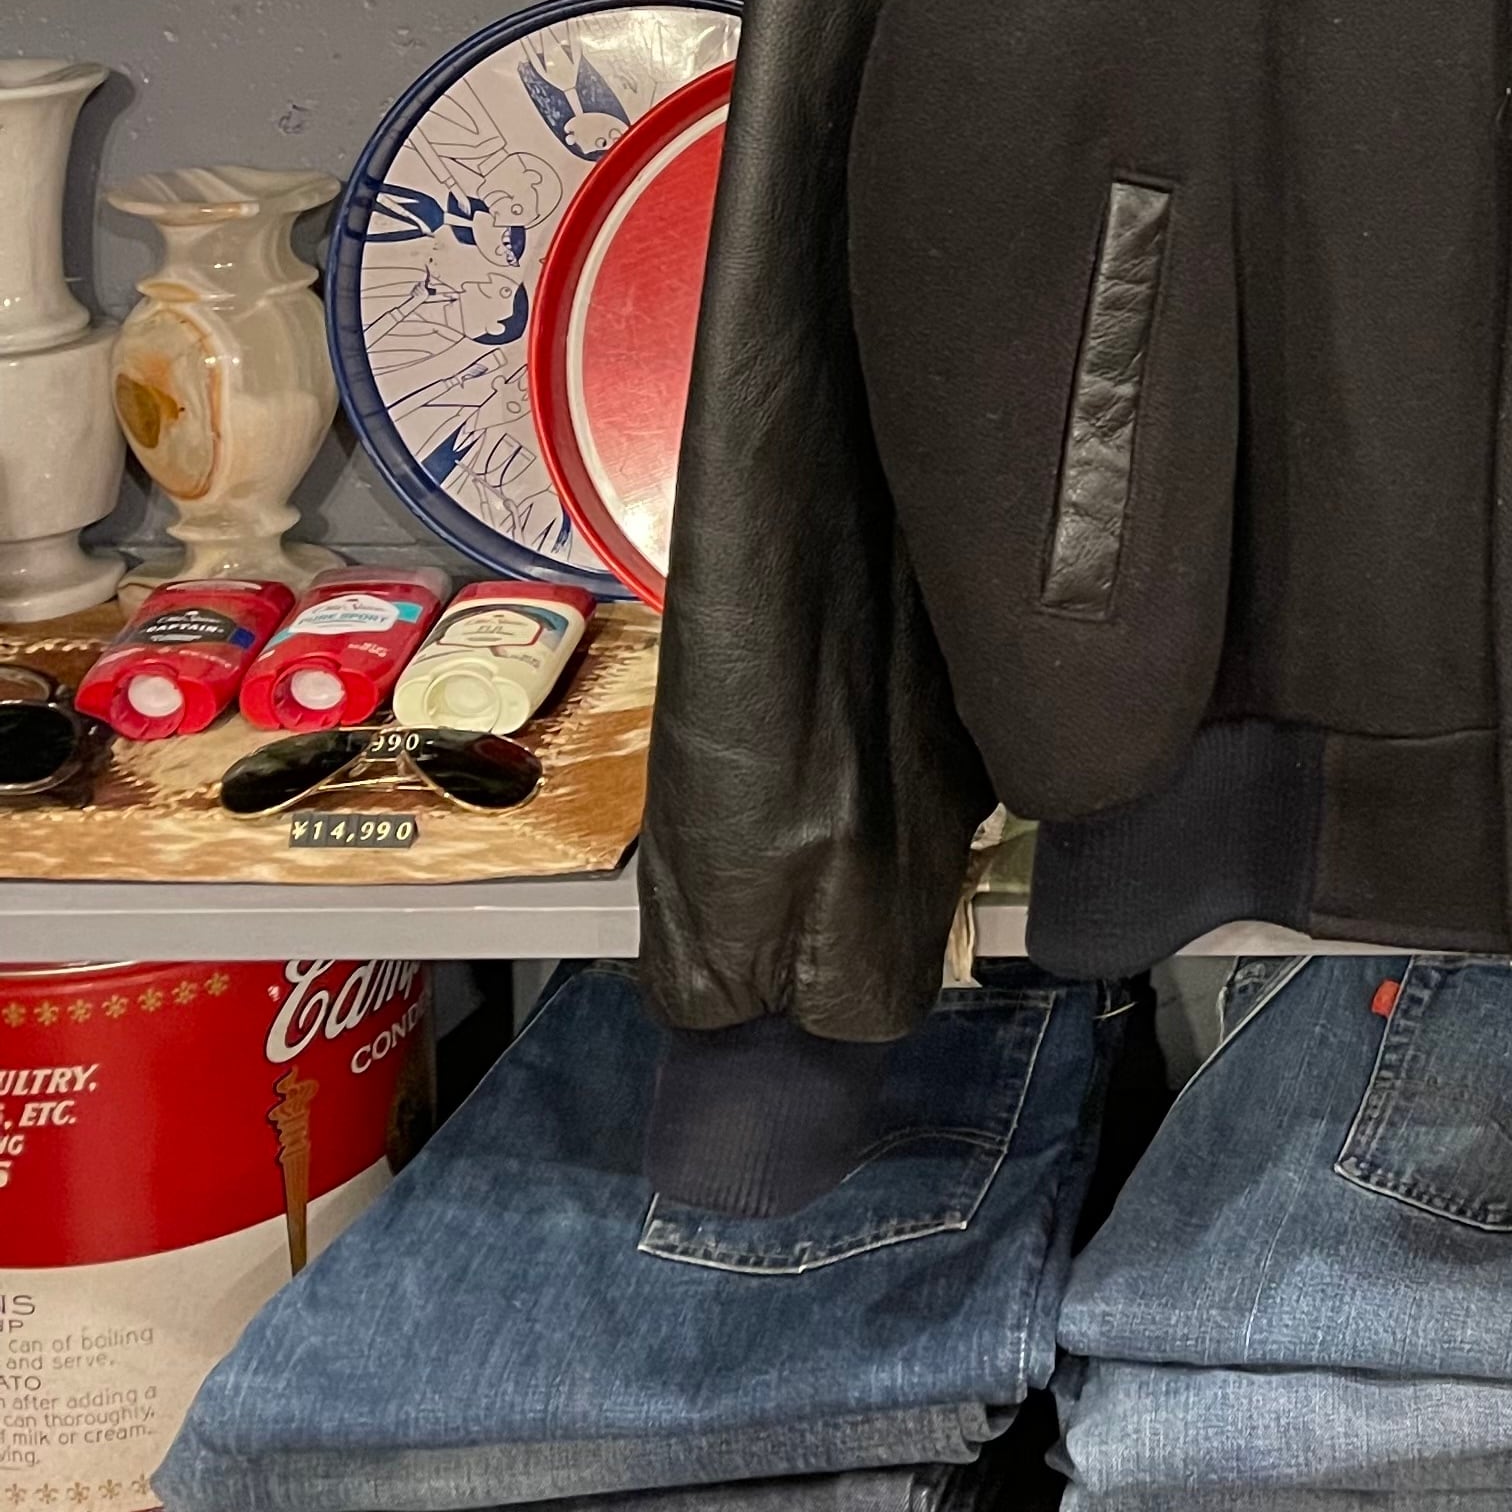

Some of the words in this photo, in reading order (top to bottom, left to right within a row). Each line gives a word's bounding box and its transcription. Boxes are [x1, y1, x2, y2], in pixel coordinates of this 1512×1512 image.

[292, 820, 413, 843] ¥14,990
[19, 1100, 77, 1127] ETC.
[8, 1339, 43, 1354] can
[52, 1335, 73, 1353] of
[82, 1326, 154, 1351] boiling
[6, 1356, 43, 1370] and
[52, 1353, 115, 1370] serve.
[13, 1394, 60, 1411] after
[66, 1388, 138, 1409] adding
[145, 1385, 157, 1400] a
[4, 1415, 37, 1428] can
[45, 1406, 155, 1428] thoroughly.
[12, 1429, 50, 1446] milk
[58, 1432, 78, 1445] or
